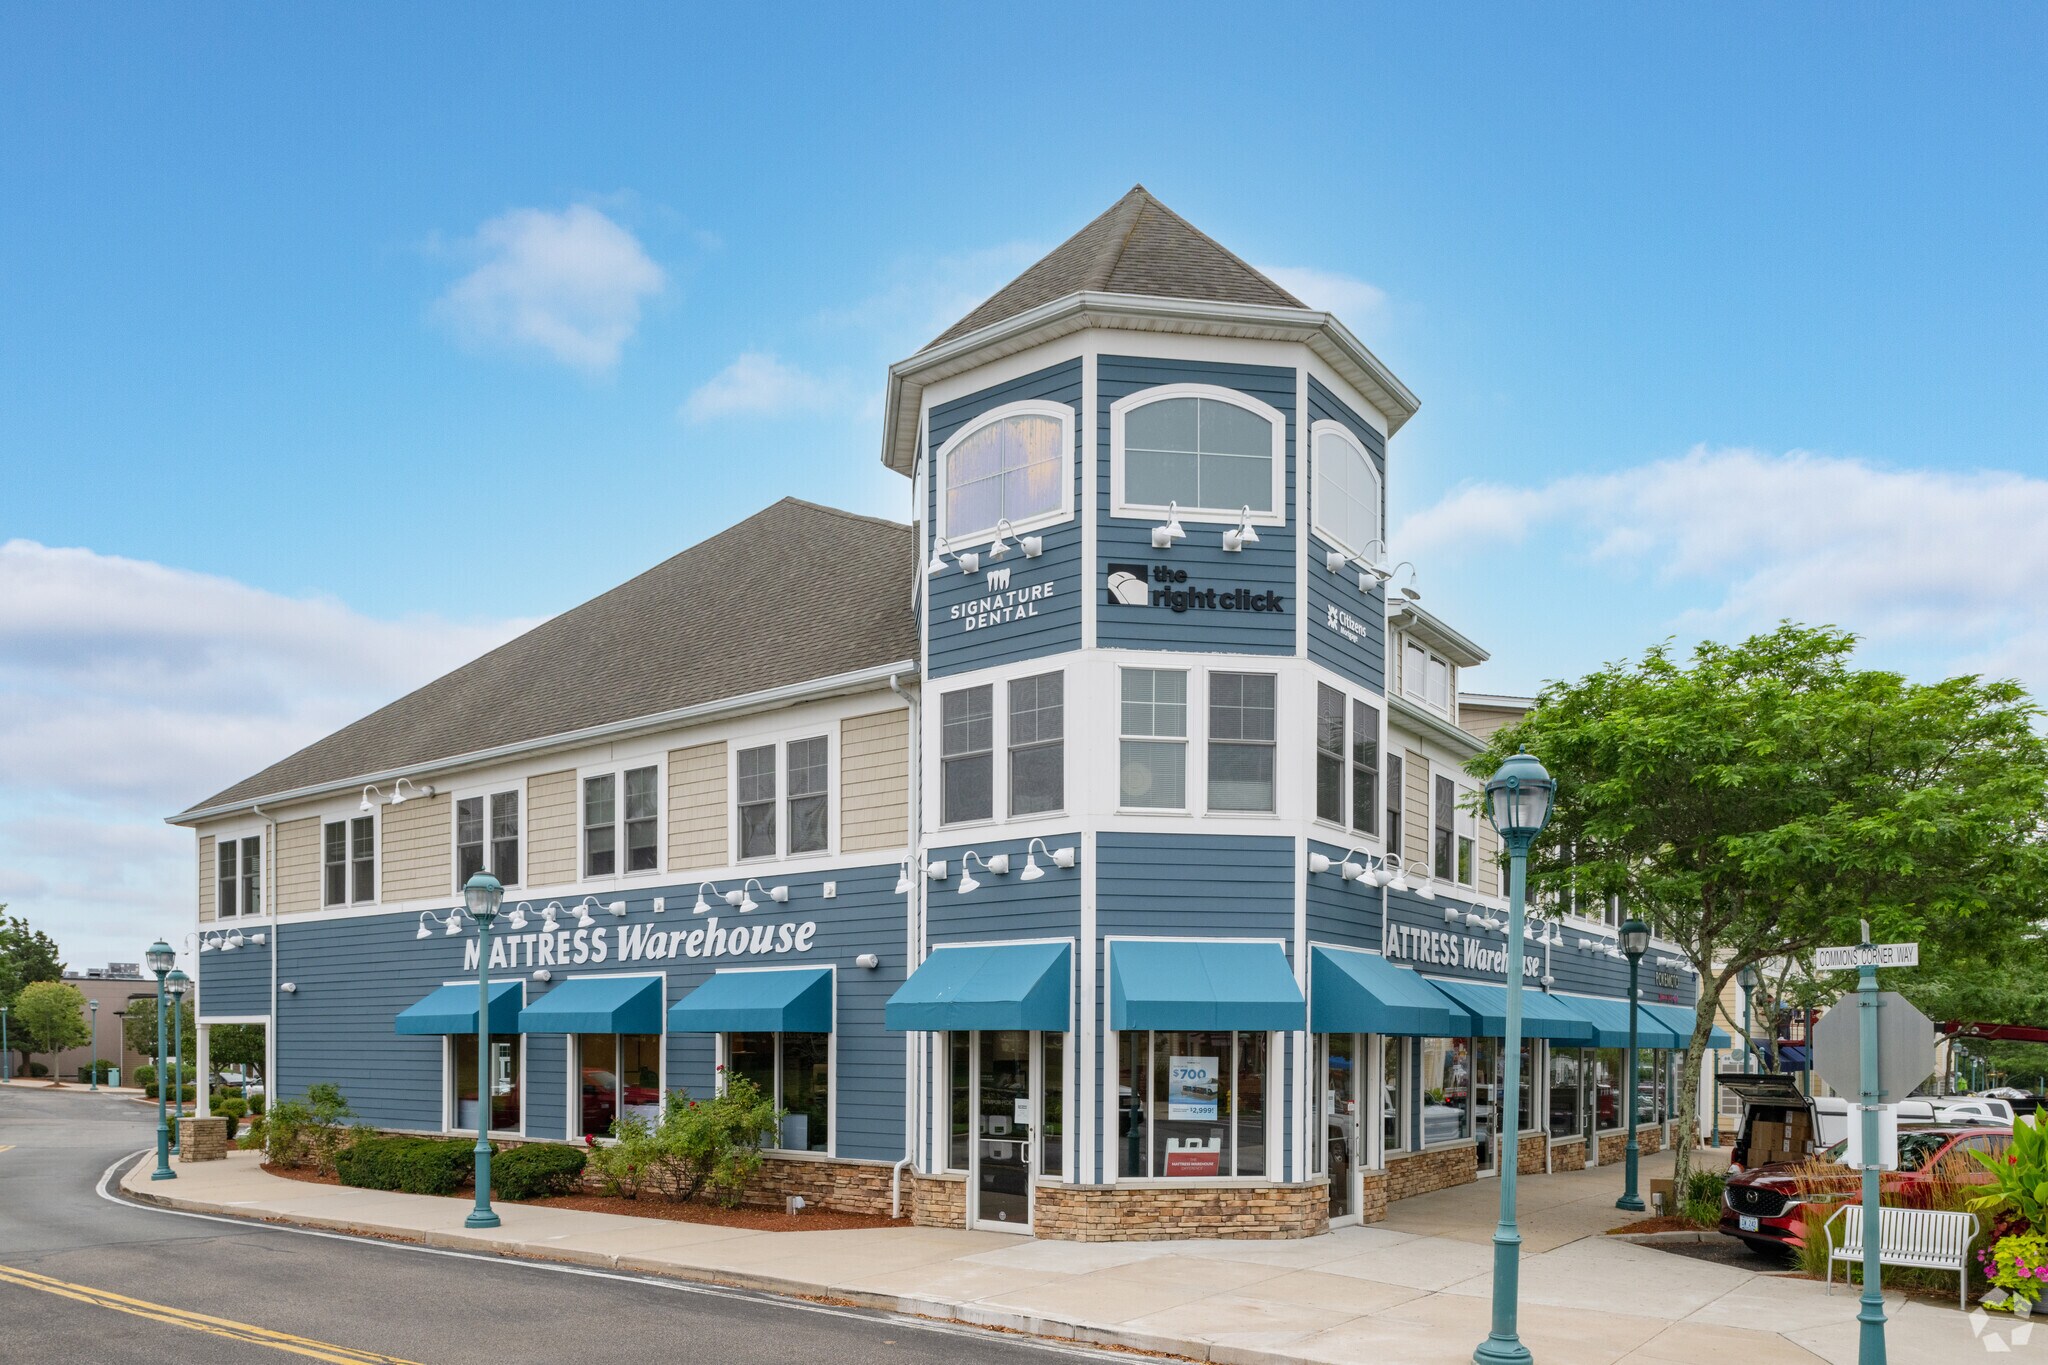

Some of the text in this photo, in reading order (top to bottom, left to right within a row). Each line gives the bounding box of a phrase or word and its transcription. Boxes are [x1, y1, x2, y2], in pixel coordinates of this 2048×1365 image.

[1153, 565, 1188, 583] the
[951, 582, 1054, 619] SIGNATURE
[966, 603, 1038, 631] DENTAL
[1339, 611, 1367, 638] Citizens
[464, 917, 817, 971] MATTRESS Warehouse
[1386, 923, 1540, 978] ATTRESS Warehse
[1820, 946, 1914, 967] COMMONS CORNER WAY
[1173, 1069, 1207, 1080] $700
